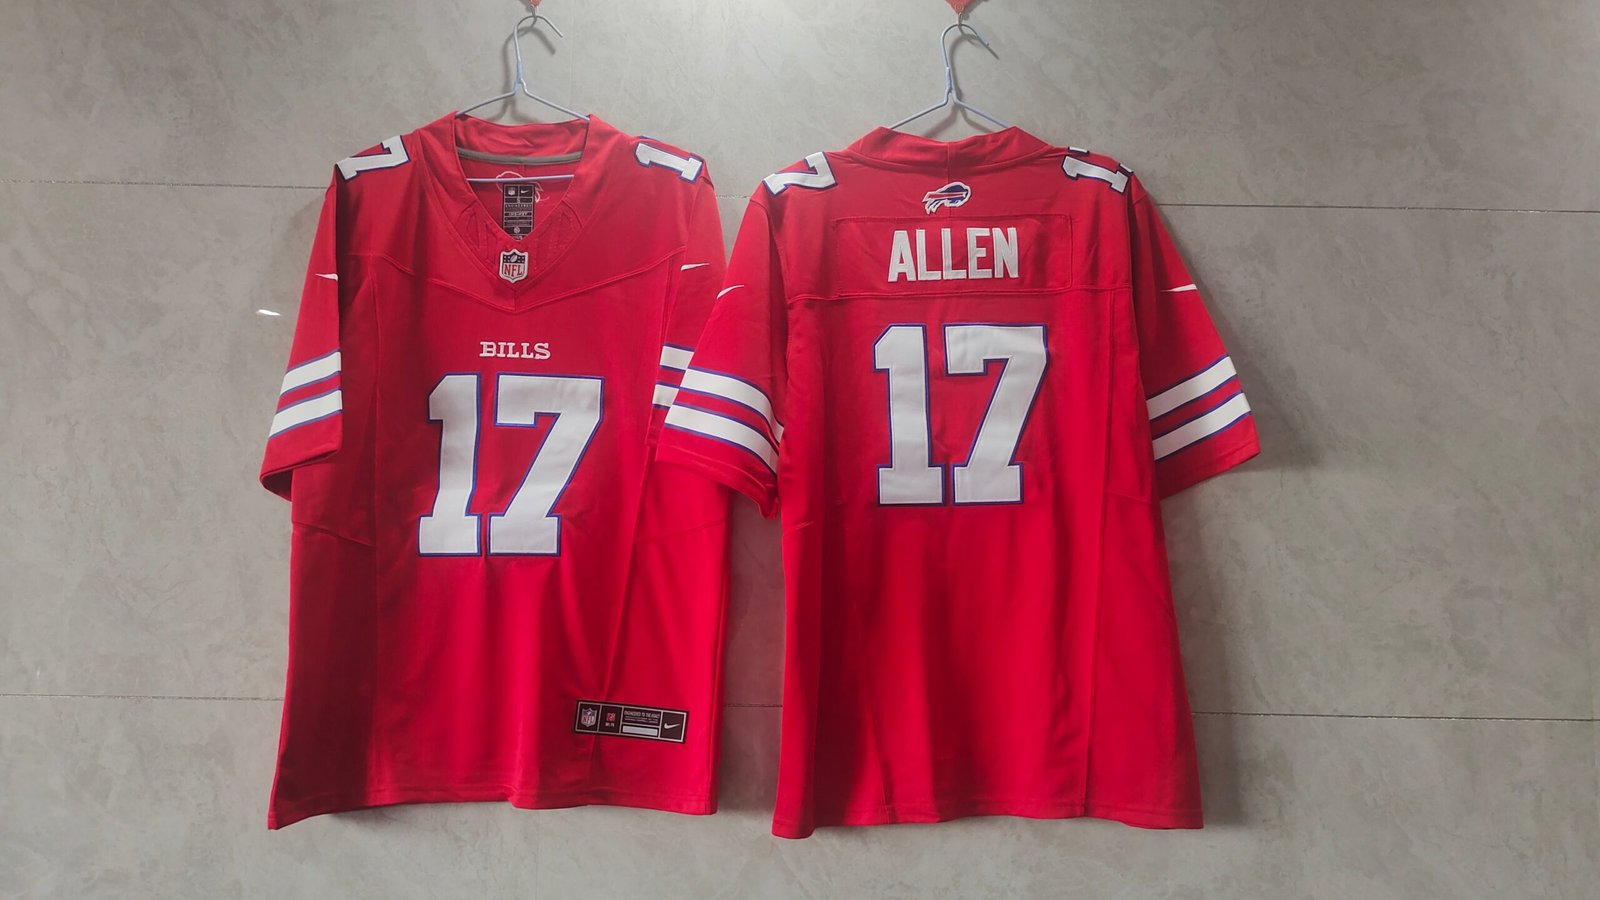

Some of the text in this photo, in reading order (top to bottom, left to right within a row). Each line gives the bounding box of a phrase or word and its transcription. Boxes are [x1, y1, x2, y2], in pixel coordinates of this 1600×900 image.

[504, 264, 523, 277] NFL
[887, 227, 1020, 282] ALLEN
[479, 341, 551, 359] BILLS
[872, 323, 1051, 507] 17
[416, 372, 605, 558] 17
